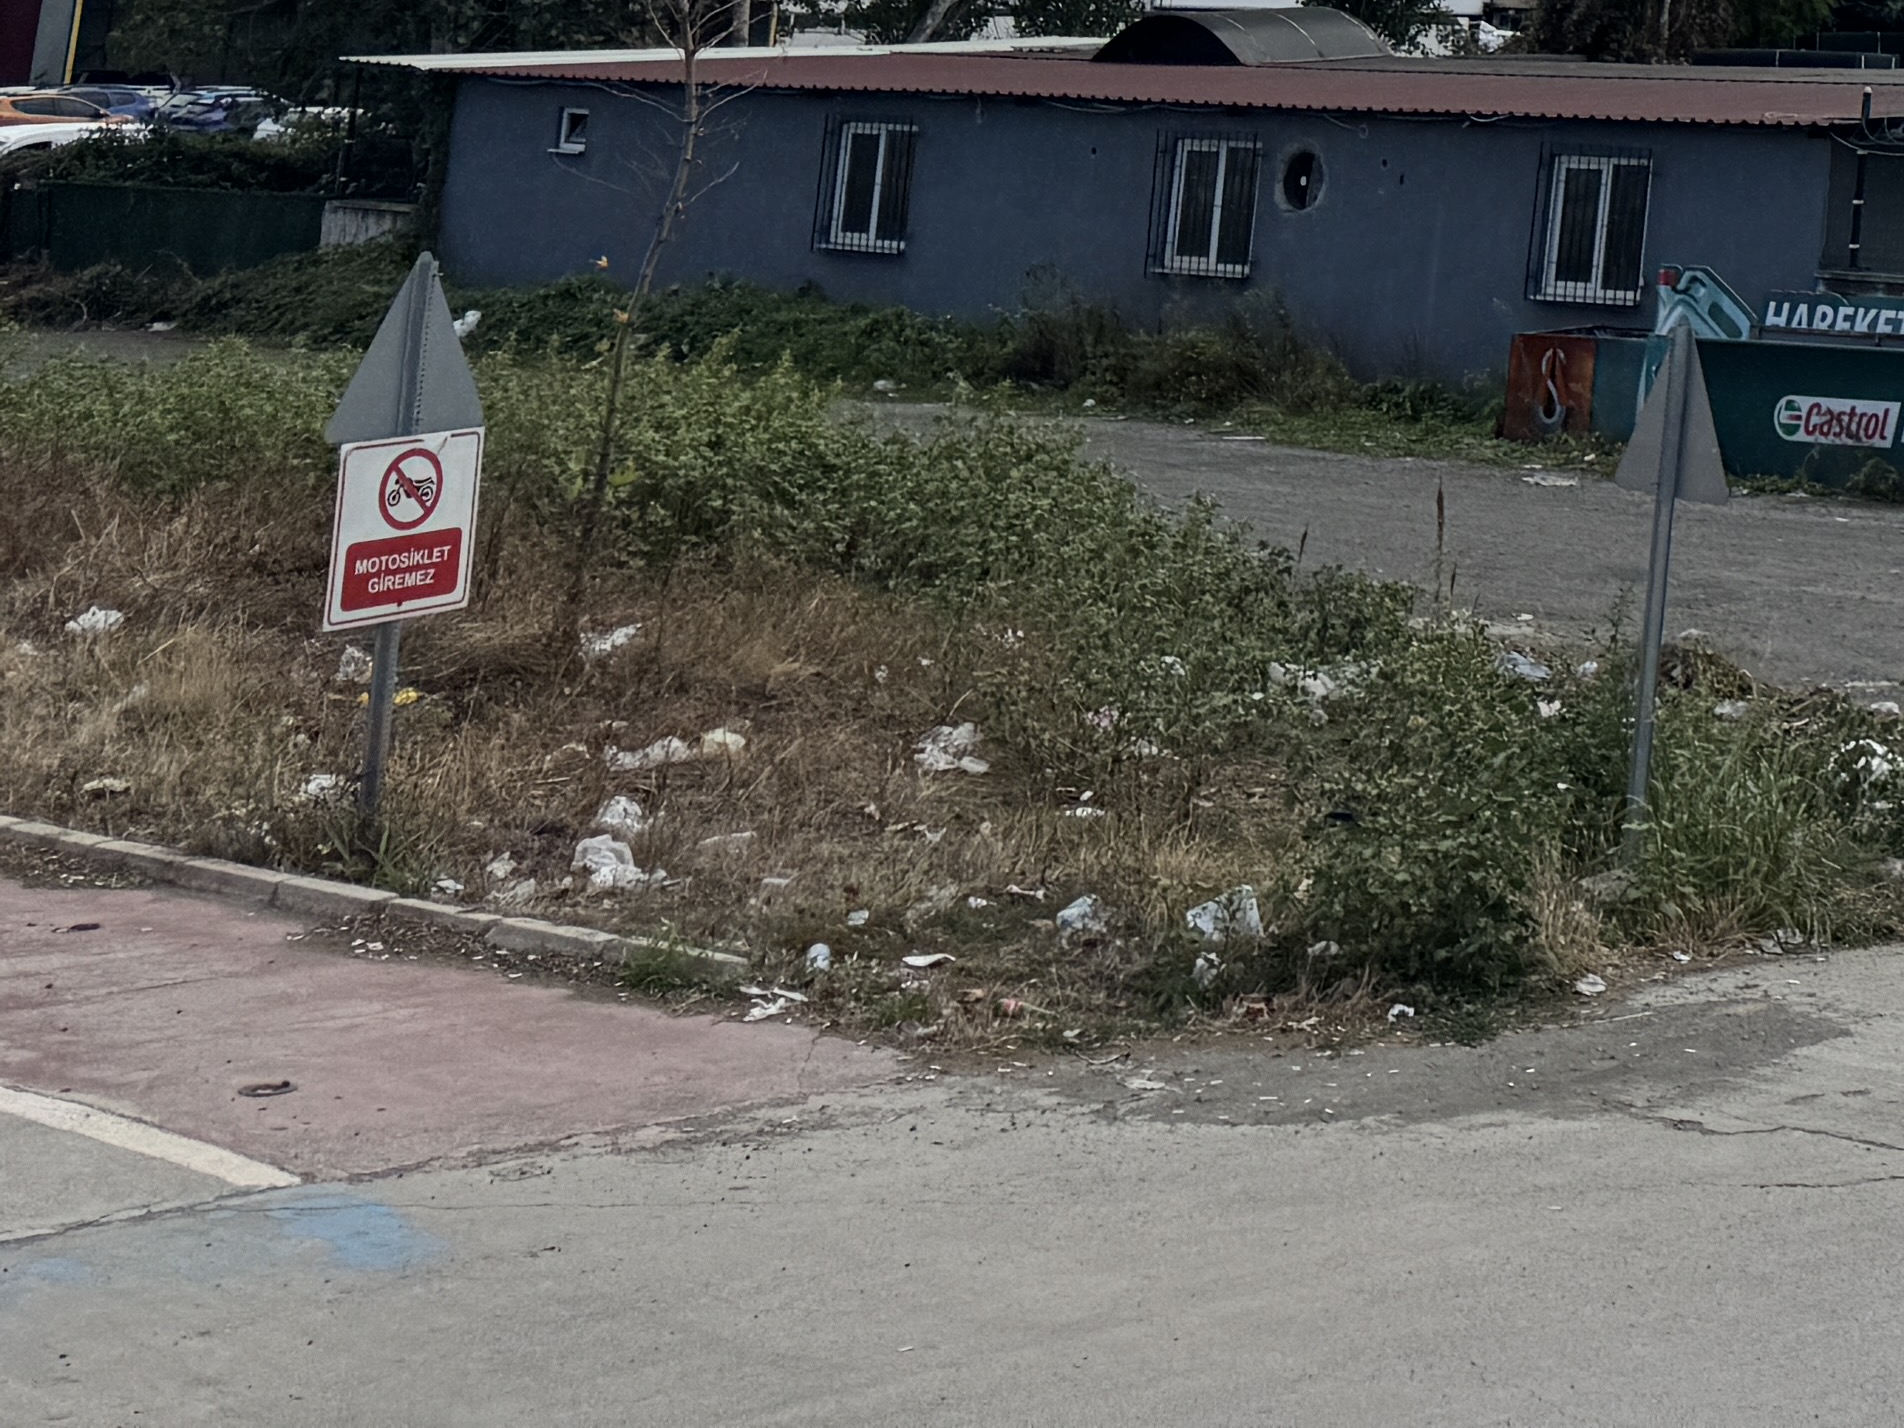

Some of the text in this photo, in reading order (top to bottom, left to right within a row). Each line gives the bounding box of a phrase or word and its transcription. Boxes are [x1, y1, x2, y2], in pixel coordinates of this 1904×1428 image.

[1804, 401, 1890, 442] Castrol
[354, 545, 452, 576] MOTOSİKLET
[367, 568, 436, 594] GİREMEZ
